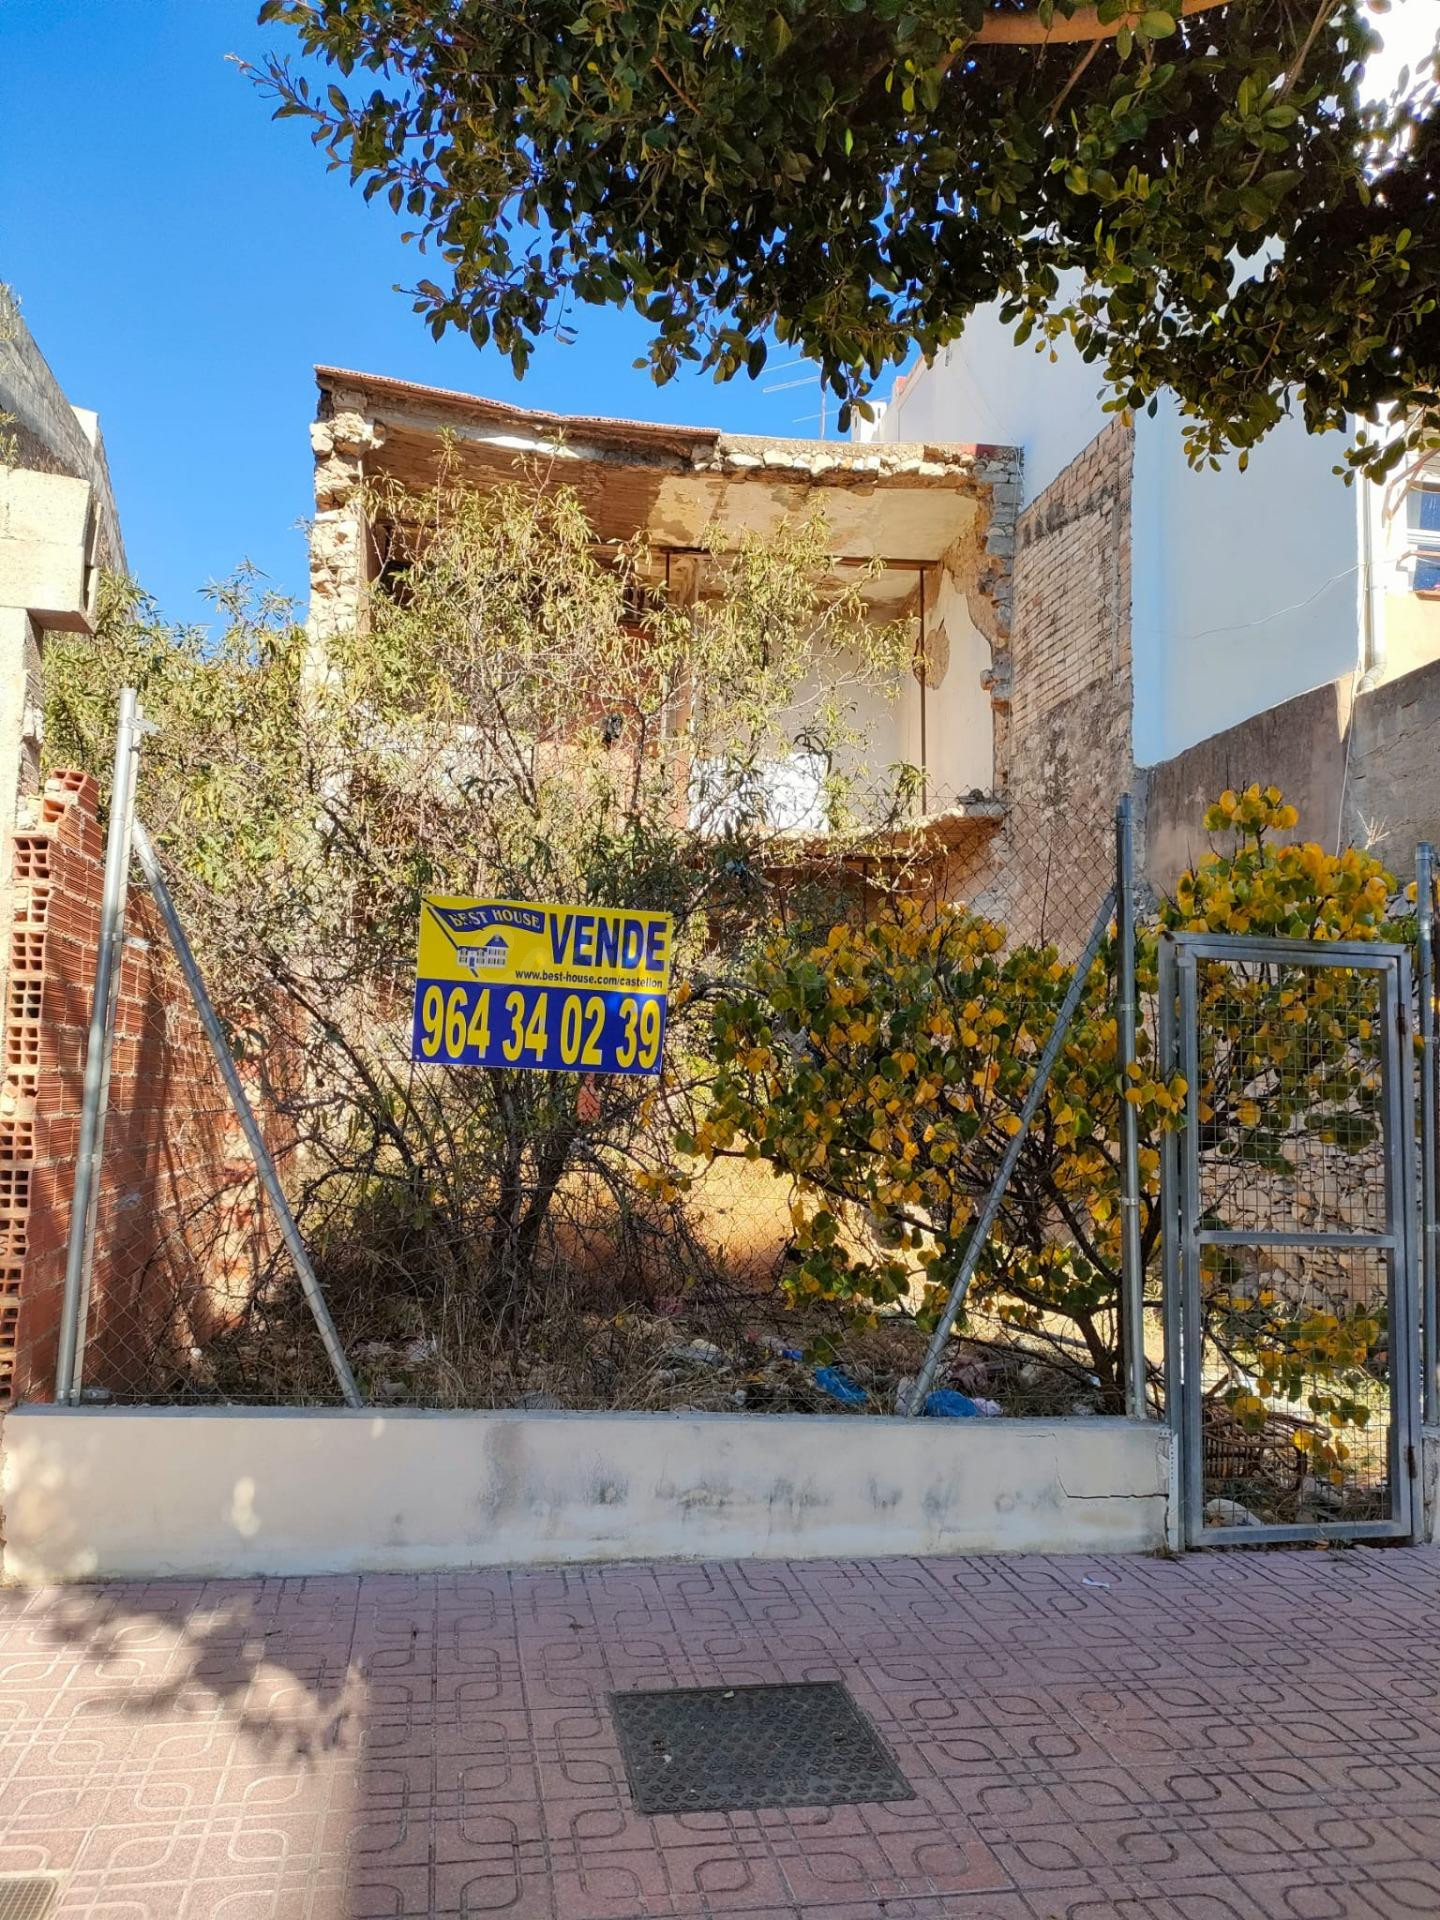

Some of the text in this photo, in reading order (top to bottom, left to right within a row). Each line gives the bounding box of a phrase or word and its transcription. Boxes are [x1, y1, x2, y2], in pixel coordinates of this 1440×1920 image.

[448, 909, 541, 928] BEST HOUSE
[549, 913, 667, 972] VENDE
[515, 969, 663, 988] www.best-house.com/castellon
[421, 985, 661, 1069] 964 34 02 39
